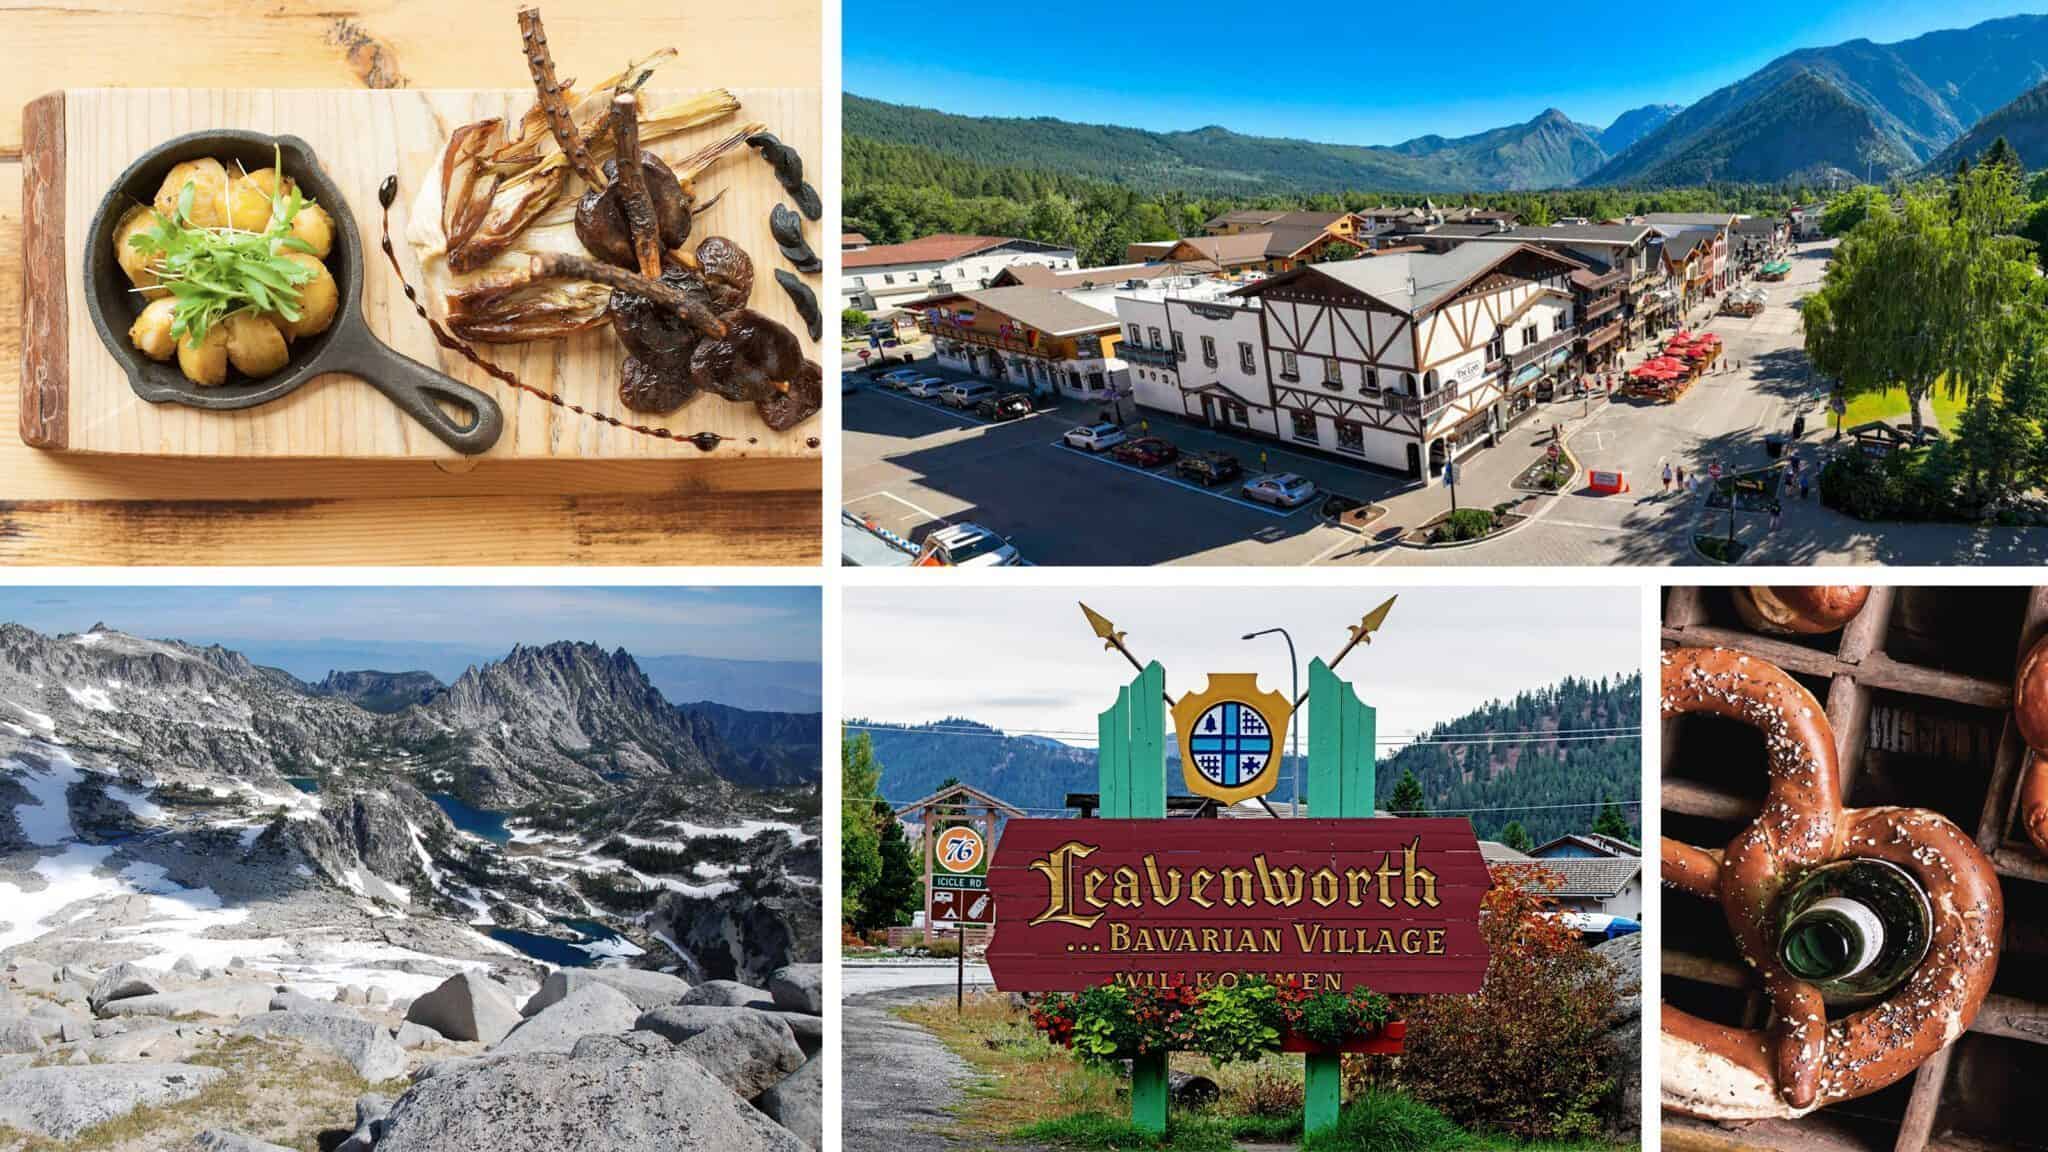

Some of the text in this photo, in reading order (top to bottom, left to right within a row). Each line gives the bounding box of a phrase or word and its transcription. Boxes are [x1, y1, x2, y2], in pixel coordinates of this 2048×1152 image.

[945, 835, 977, 863] 76
[937, 877, 982, 888] ICICLE RD
[1028, 835, 1441, 929] Leavenworth
[1293, 922, 1447, 955] VILLAGE
